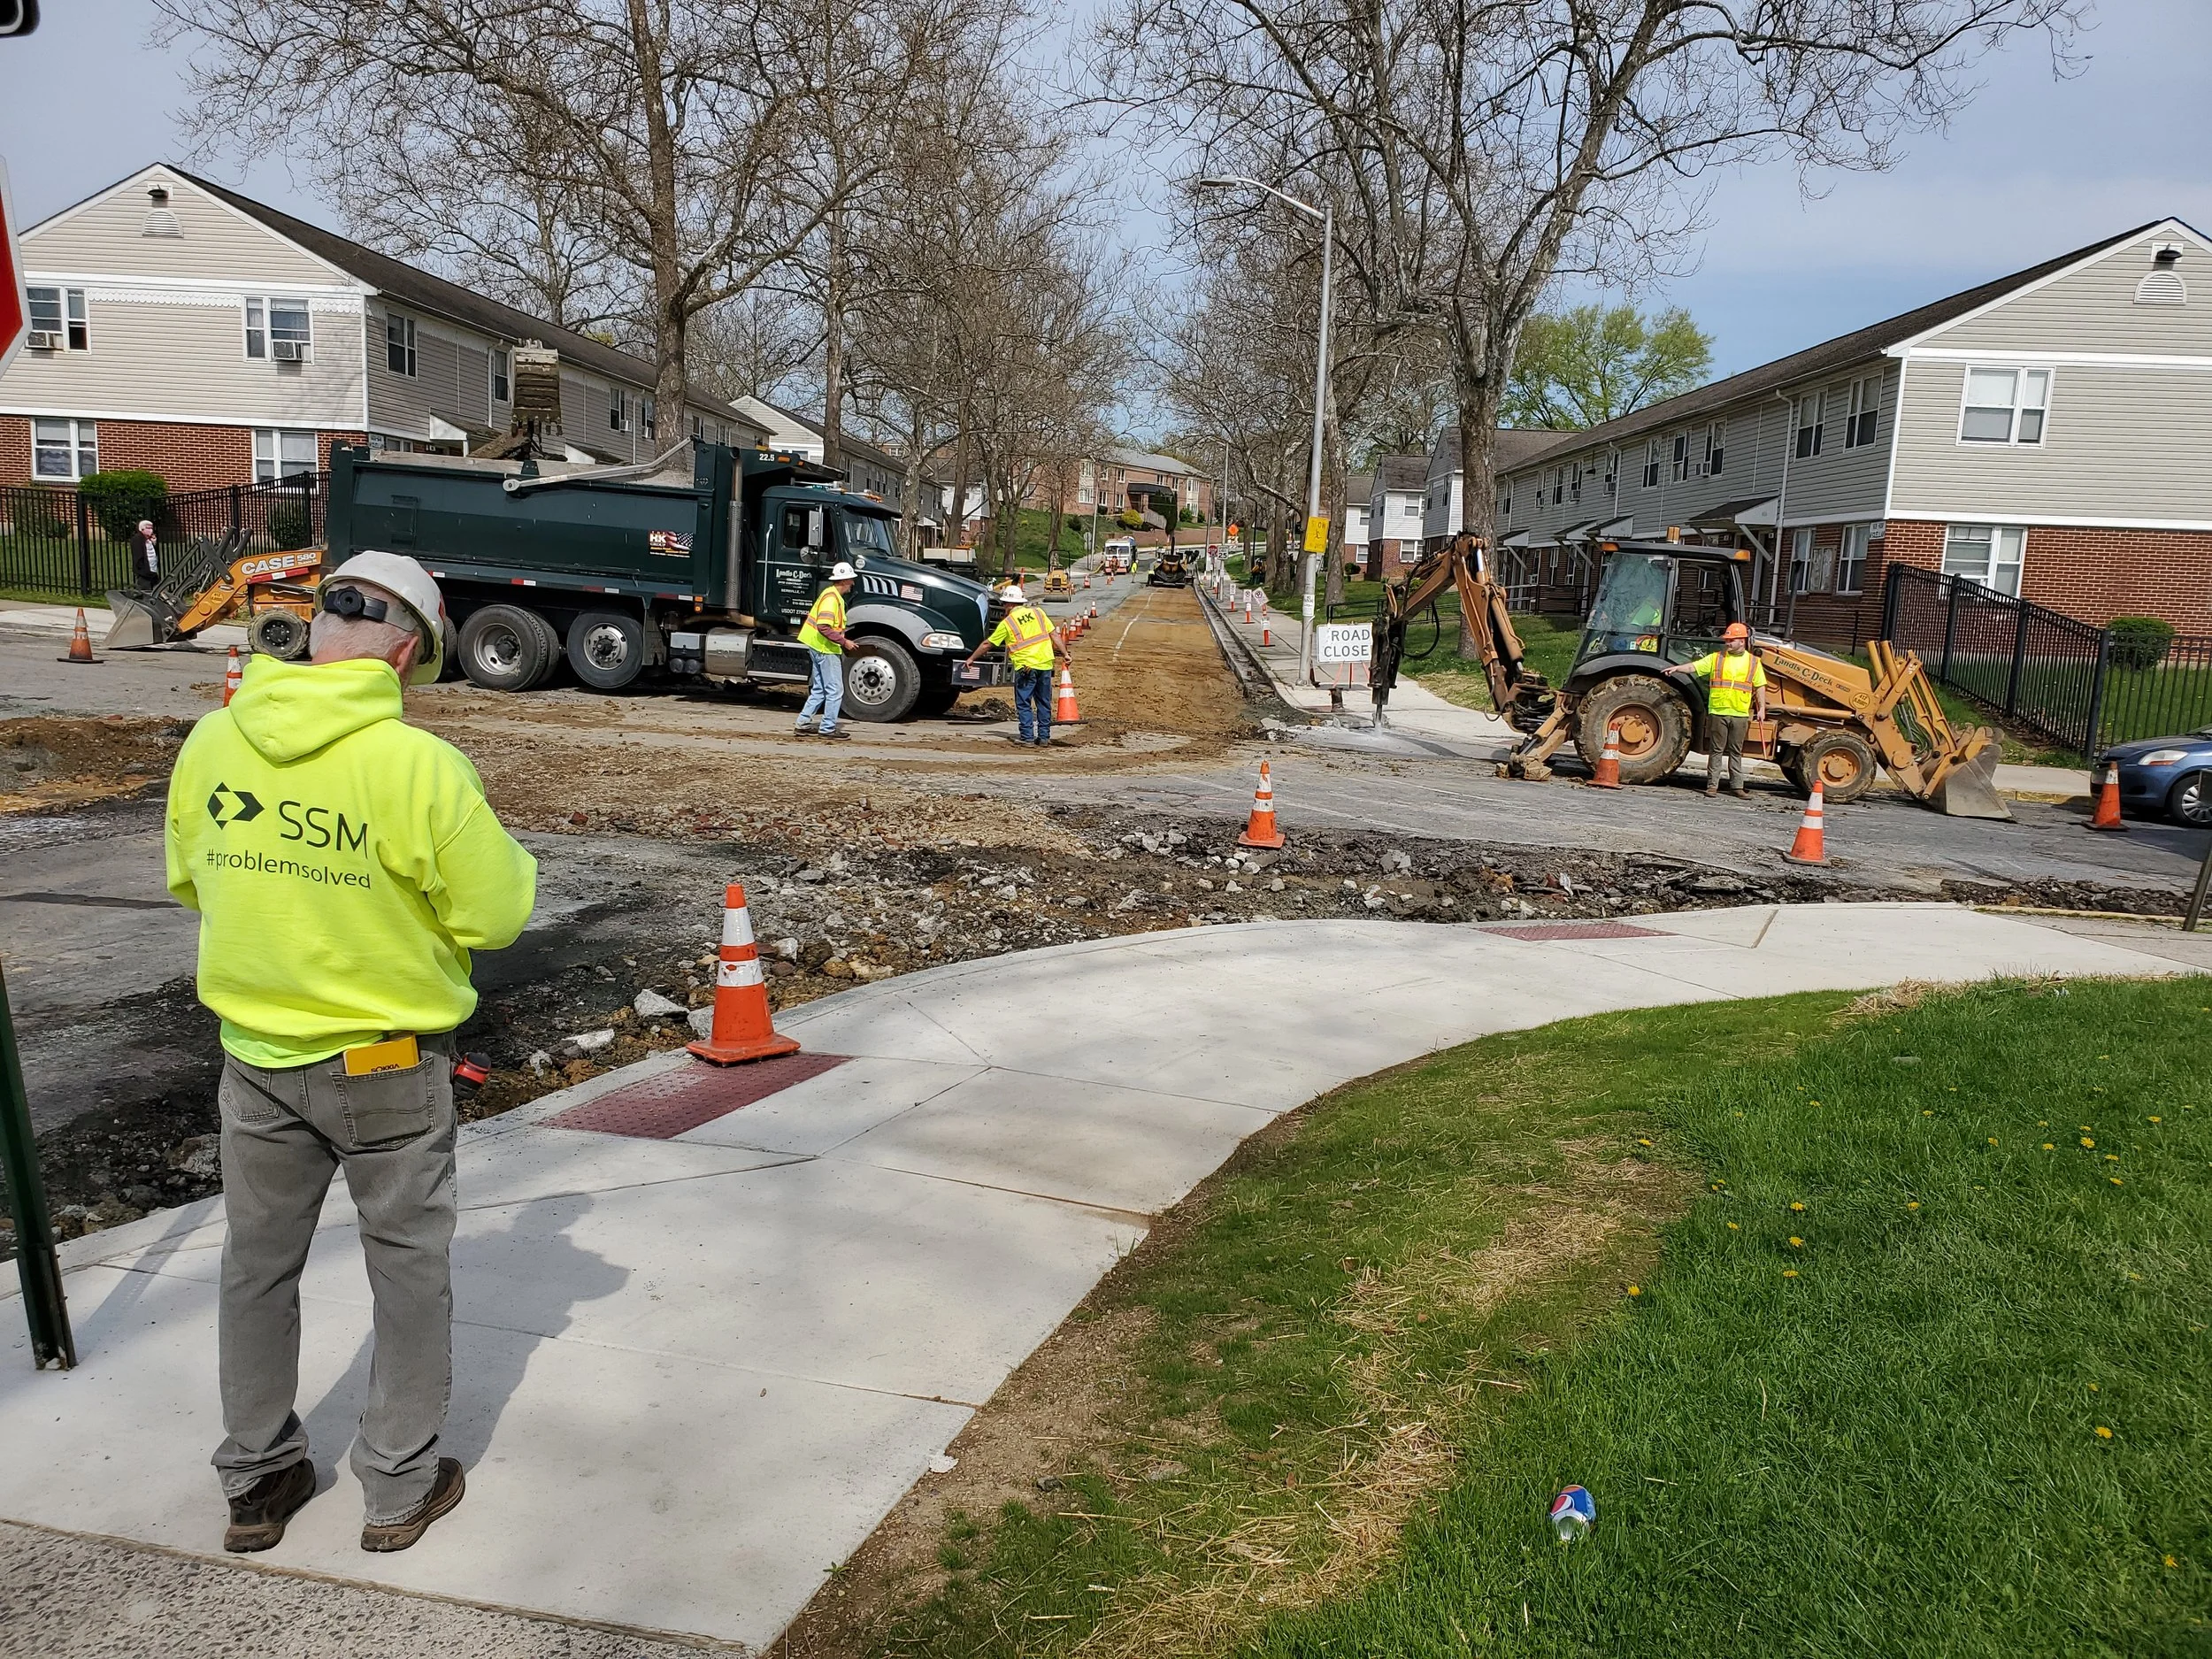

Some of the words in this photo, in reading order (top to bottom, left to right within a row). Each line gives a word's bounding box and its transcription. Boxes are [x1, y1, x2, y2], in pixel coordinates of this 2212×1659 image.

[759, 453, 775, 462] 22.5
[242, 554, 295, 575] CASE
[1331, 629, 1370, 641] ROAD
[1324, 644, 1371, 657] CLOSE
[1773, 656, 1801, 672] Landis
[1811, 672, 1833, 687] Deck
[279, 800, 368, 859] SSM
[206, 849, 371, 889] #problemsolved
[371, 1063, 400, 1073] SOKKIA
